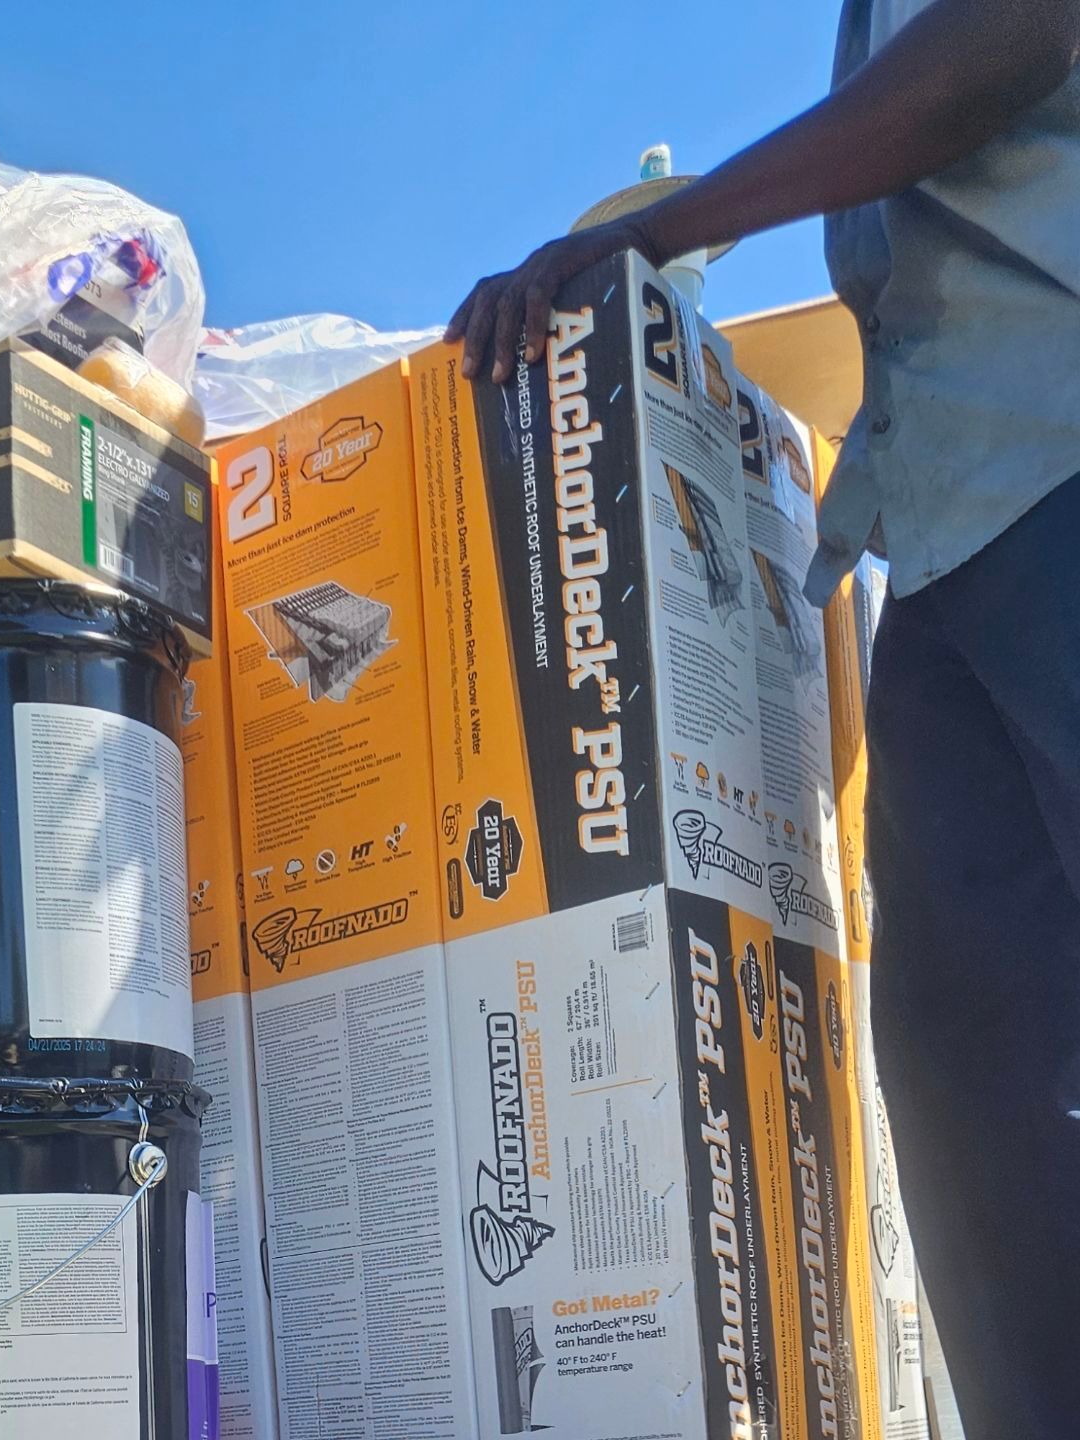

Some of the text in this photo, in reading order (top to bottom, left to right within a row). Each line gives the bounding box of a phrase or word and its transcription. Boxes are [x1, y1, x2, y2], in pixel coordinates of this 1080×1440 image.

[642, 281, 681, 394] 2
[80, 424, 93, 501] FRAMING
[98, 455, 129, 480] ELECTRO
[129, 471, 169, 501] GALVANIZED
[312, 431, 373, 473] 20 Year
[521, 433, 538, 513] SYNTHETIC
[186, 490, 198, 508] 15
[226, 433, 291, 543] 2 SQUARE ROLL
[227, 506, 355, 568] More than just ice dam protection
[447, 358, 481, 755] Premium protection from Ice Dams, Wind-Driven Rain, Snow & Water
[526, 515, 540, 550] ROOF
[529, 555, 548, 669] UNDERLAYMENT
[571, 722, 630, 856] PSU
[734, 787, 744, 803] HT
[351, 840, 374, 860] HT
[444, 815, 455, 836] ES
[484, 815, 501, 888] 20 Year
[702, 839, 762, 888] ROOFNADO
[291, 898, 408, 953] ROOFNADO
[516, 960, 538, 1013] PSU
[688, 926, 725, 1075] PSU
[748, 951, 759, 998] Year
[566, 996, 578, 1083] Coverage: Squares
[779, 969, 812, 1103] PSU
[486, 1012, 531, 1213] ROOFNADO
[740, 1143, 756, 1260] UNDERLAYMENT
[823, 1165, 839, 1273] UNDERLAYMENT
[552, 1288, 661, 1317] Got Metal?
[749, 1262, 758, 1299] ROOF
[555, 1326, 667, 1349] can handle the heat!
[632, 1313, 656, 1326] PSU
[750, 1301, 763, 1381] SYNTHETIC
[558, 1362, 633, 1376] temperature range
[573, 1356, 579, 1364] F
[580, 1355, 589, 1363] to
